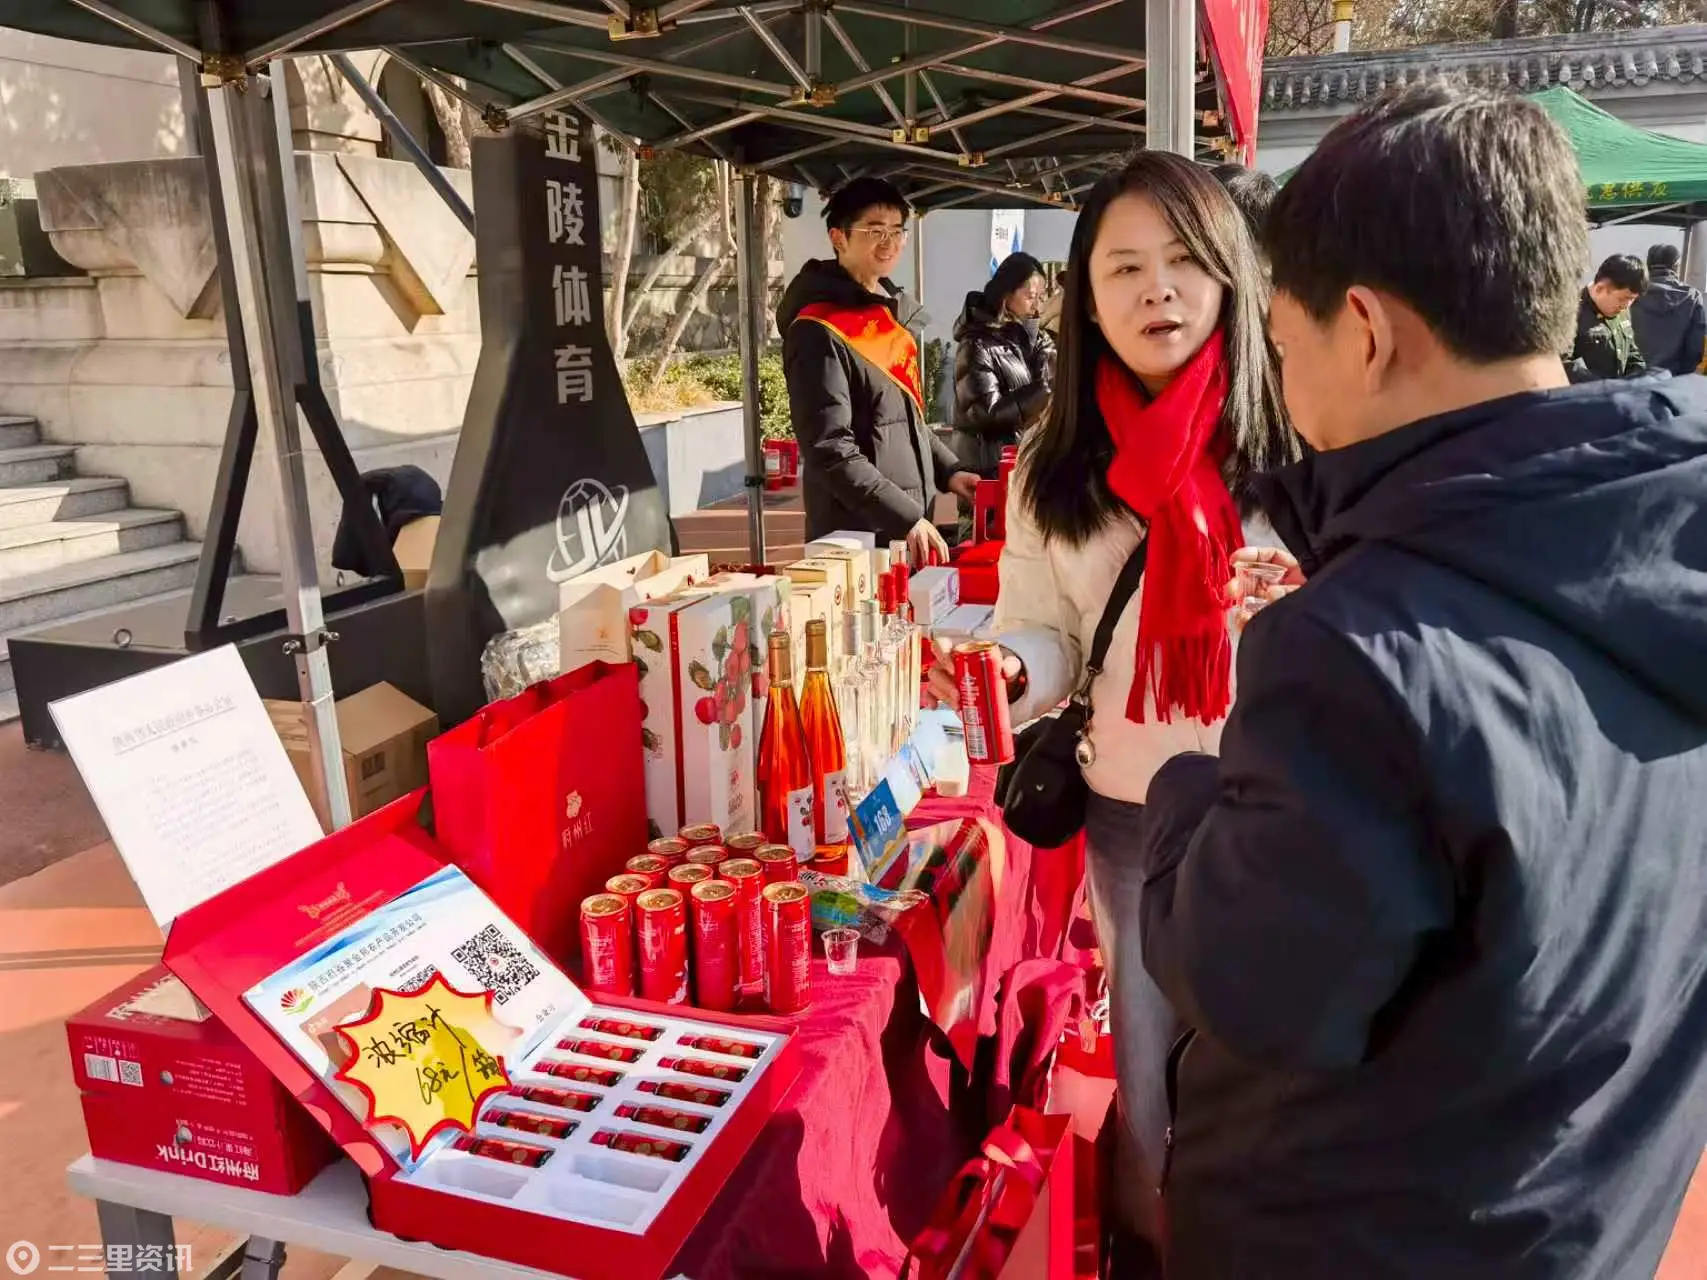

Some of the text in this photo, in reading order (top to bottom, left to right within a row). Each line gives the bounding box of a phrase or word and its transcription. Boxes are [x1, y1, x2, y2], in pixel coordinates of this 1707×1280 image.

[544, 111, 593, 404] 金陵体育
[362, 1004, 466, 1068] 浓缩汁
